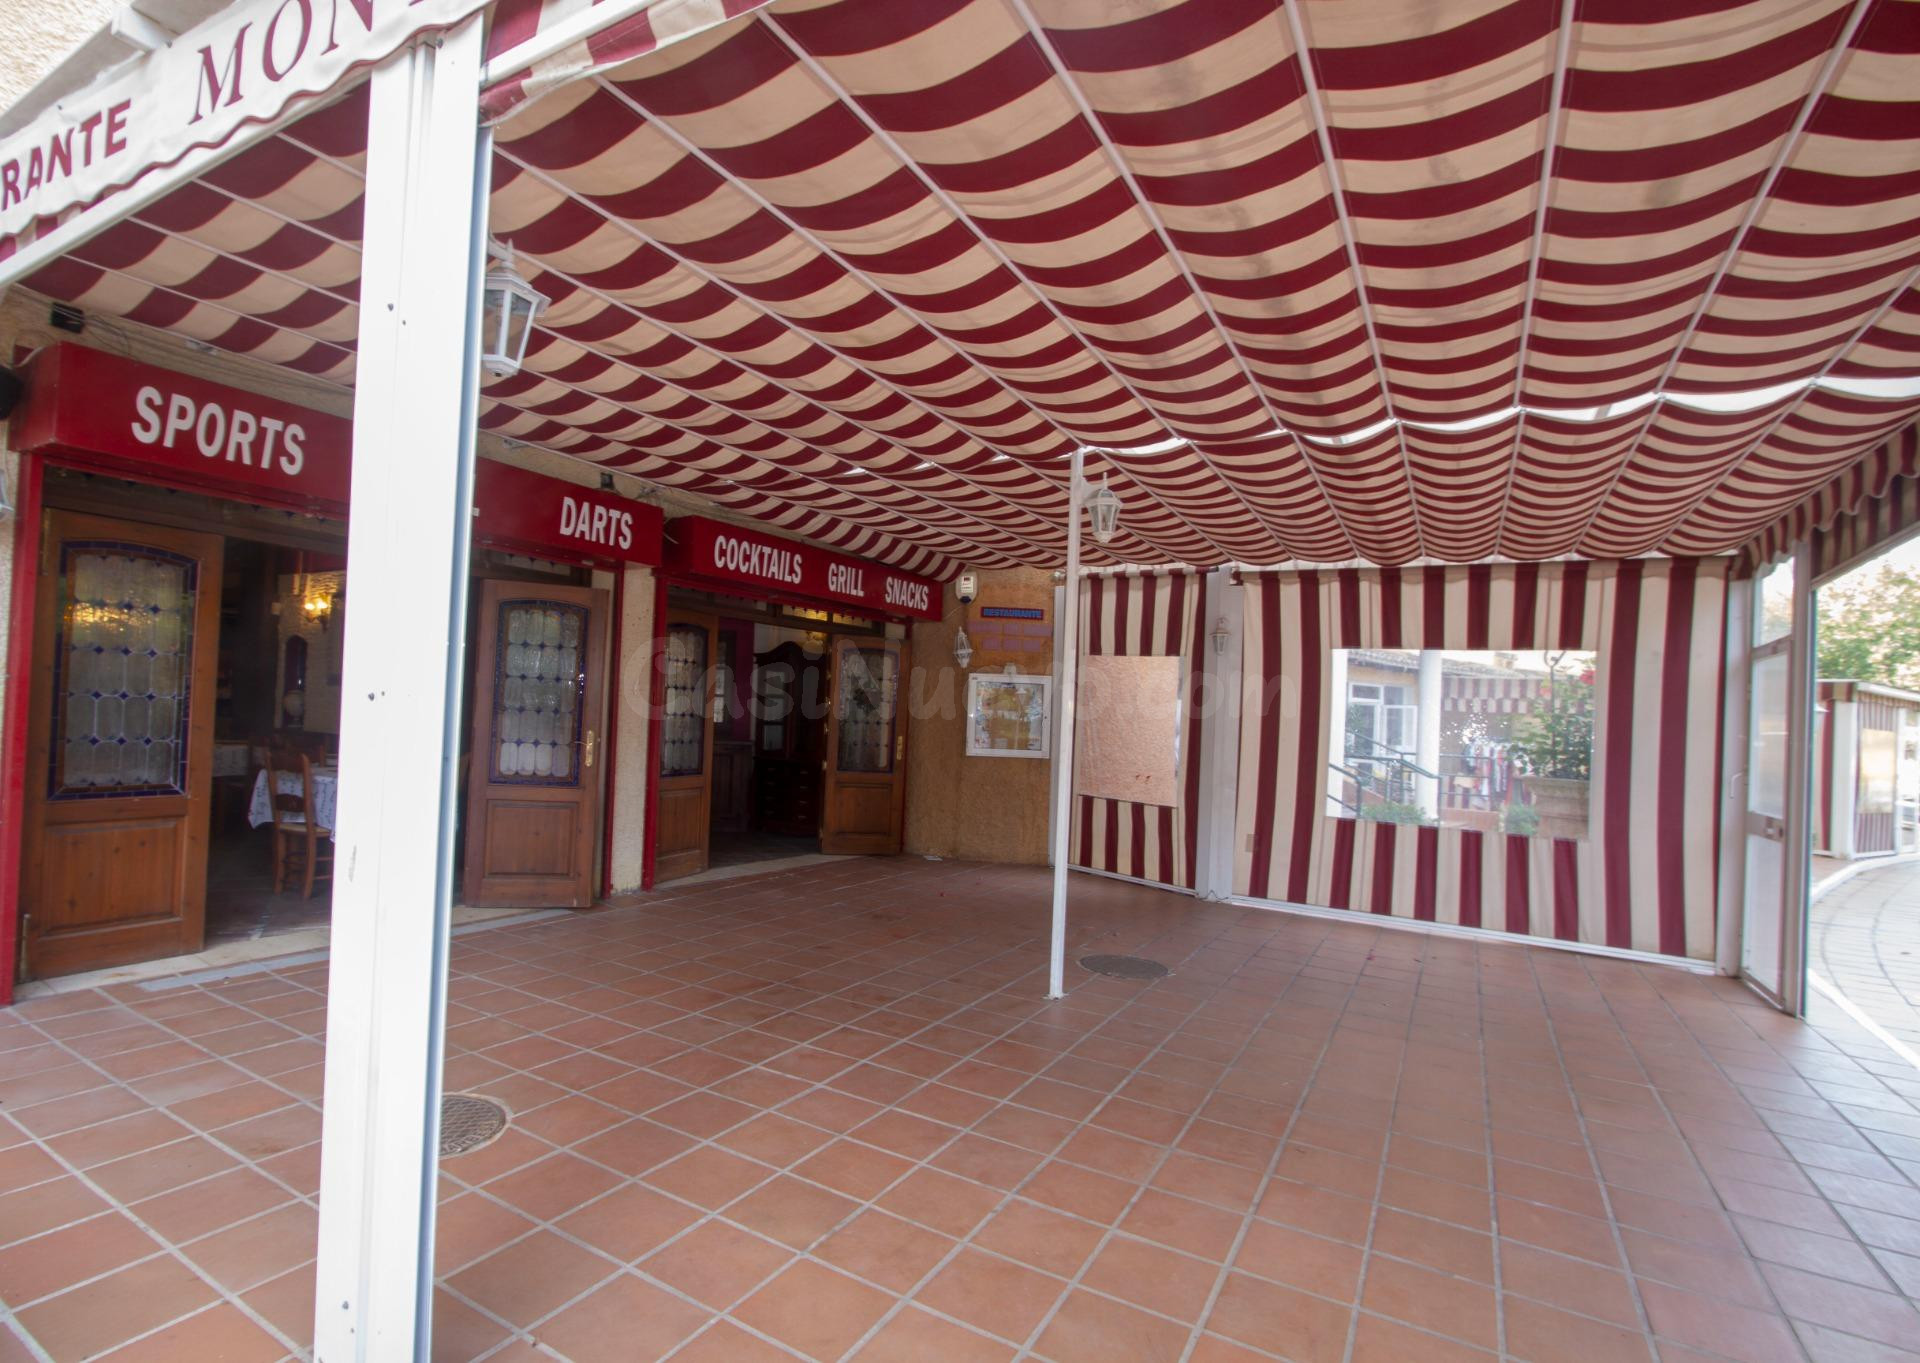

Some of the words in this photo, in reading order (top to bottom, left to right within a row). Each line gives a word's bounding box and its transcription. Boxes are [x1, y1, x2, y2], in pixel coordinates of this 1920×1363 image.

[131, 386, 306, 476] SPORTS
[559, 496, 633, 551] DARTS
[714, 535, 801, 585] COCKTAILS
[828, 562, 865, 598] GRILL
[885, 576, 929, 612] SNACKS
